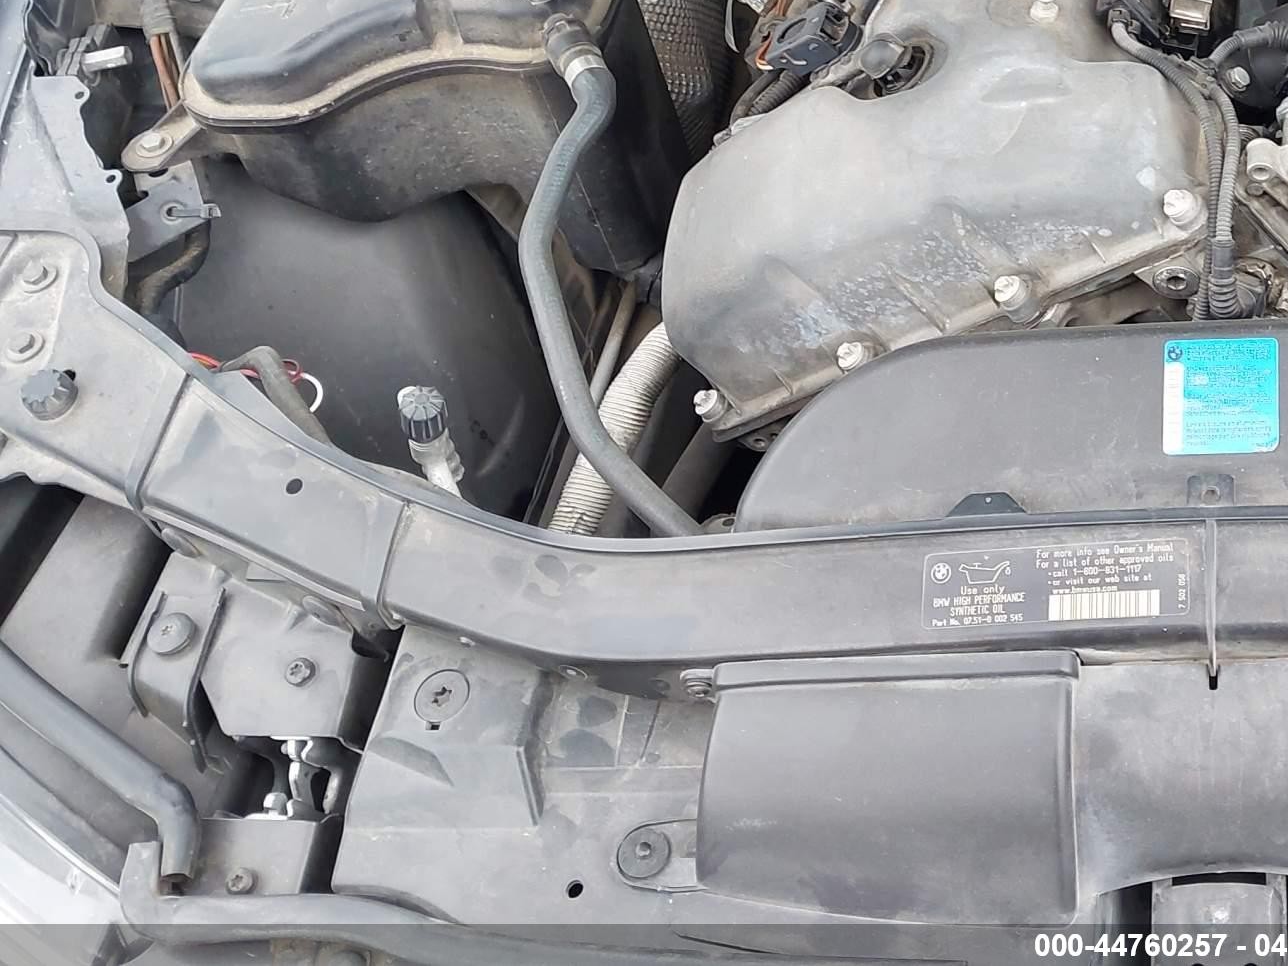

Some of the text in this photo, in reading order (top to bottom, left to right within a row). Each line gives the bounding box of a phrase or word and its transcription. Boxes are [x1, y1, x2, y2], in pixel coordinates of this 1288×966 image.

[1036, 549, 1049, 558] For
[1077, 546, 1092, 556] info
[1036, 559, 1049, 569] For
[1063, 557, 1077, 567] list
[1081, 556, 1090, 566] of
[1094, 555, 1115, 565] other
[1119, 553, 1154, 565] approved
[1158, 553, 1174, 562] oils
[1065, 577, 1083, 585] visit
[1105, 574, 1120, 583] web
[1123, 574, 1140, 582] site
[960, 584, 1006, 595] Use only
[933, 592, 1026, 608] BMW HIGH PERFORMANCE
[950, 604, 1006, 616] SYNTHETIC OIL
[932, 618, 947, 626] Part
